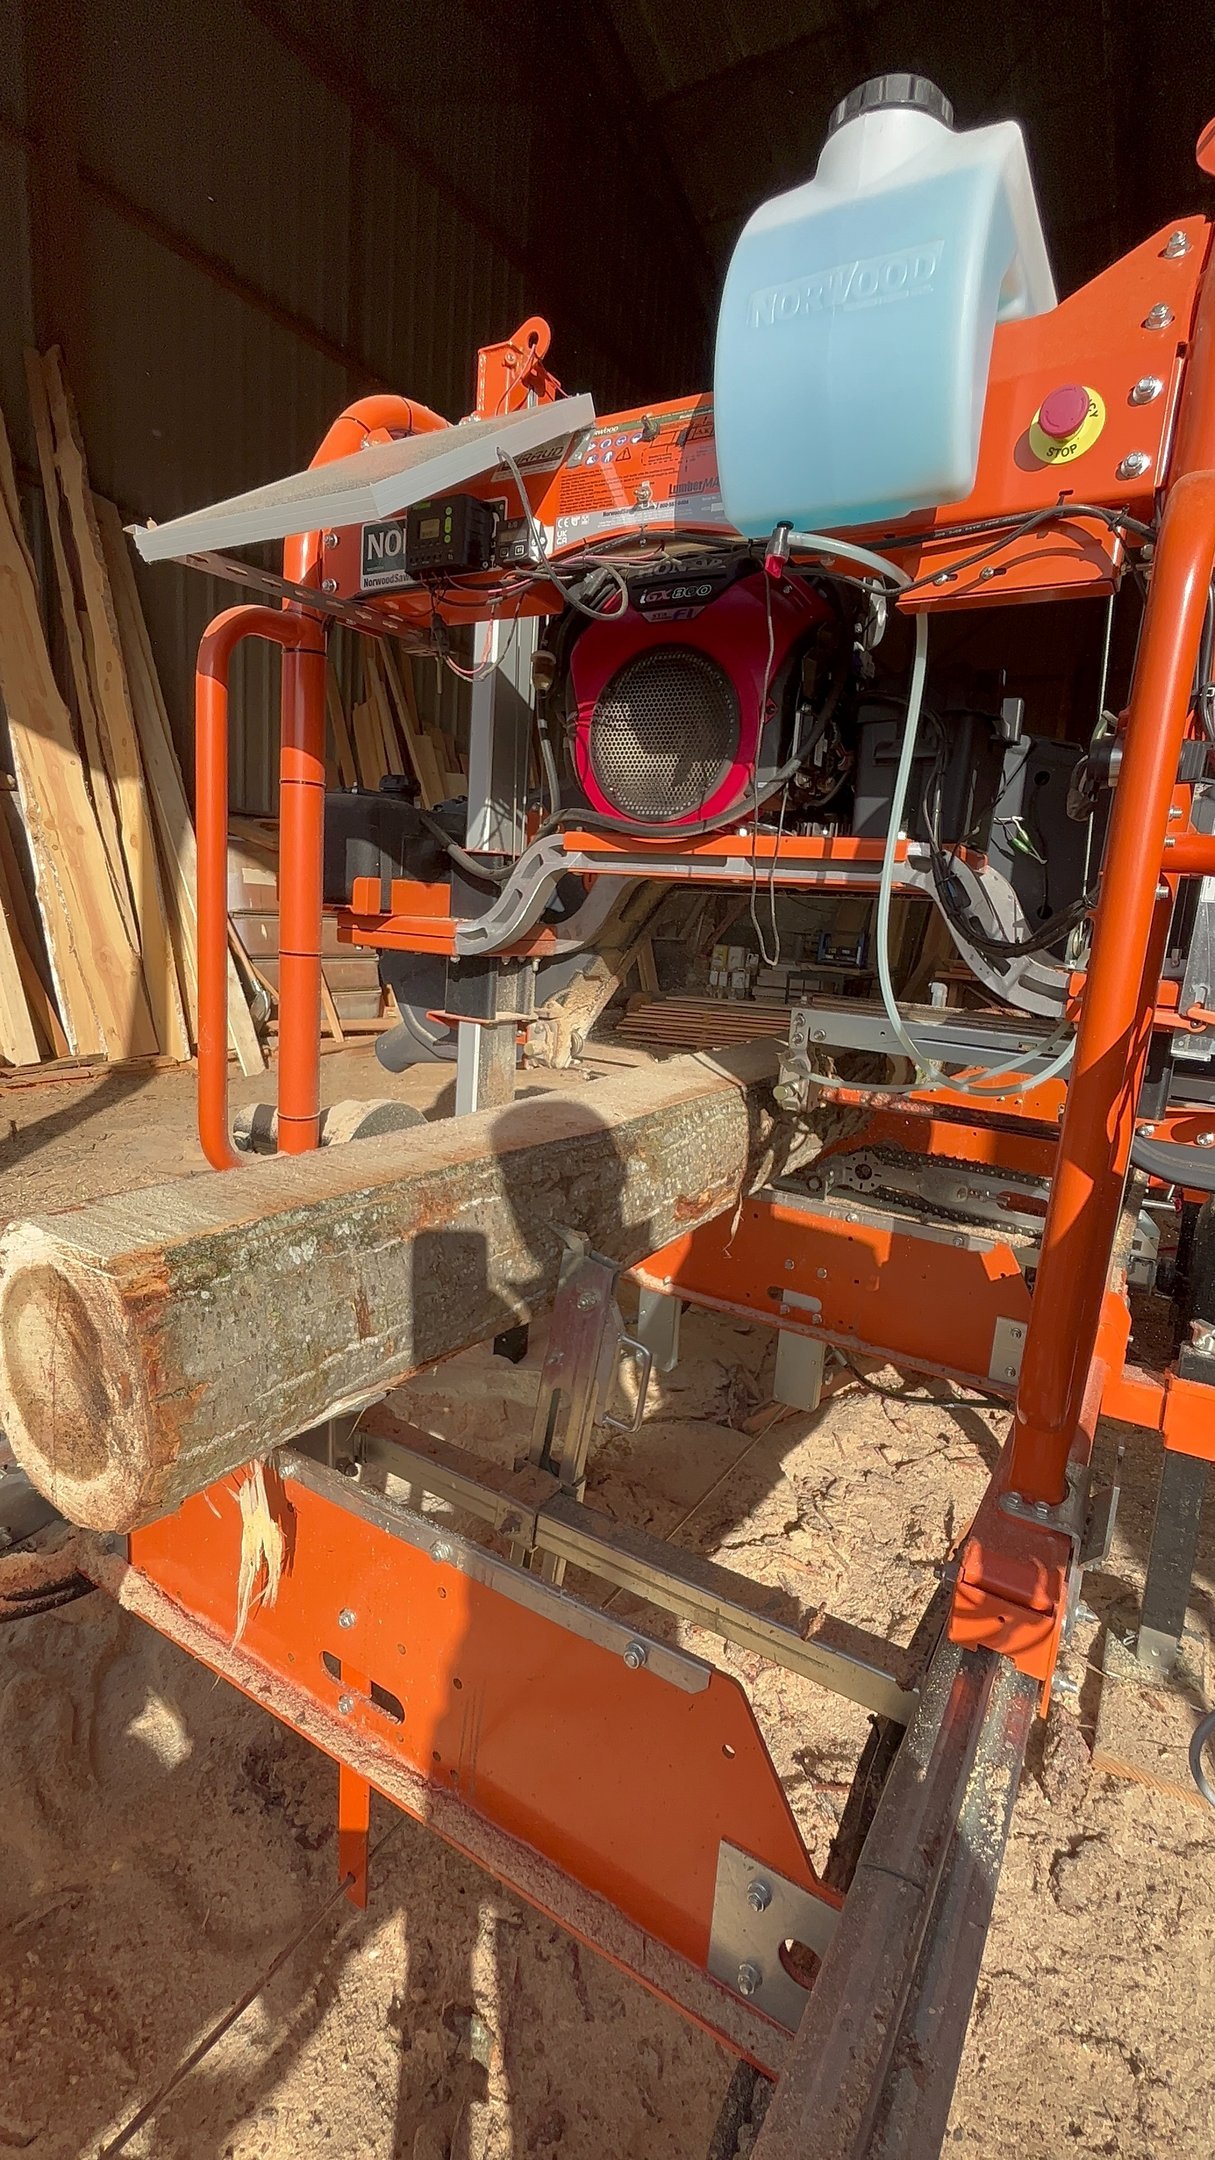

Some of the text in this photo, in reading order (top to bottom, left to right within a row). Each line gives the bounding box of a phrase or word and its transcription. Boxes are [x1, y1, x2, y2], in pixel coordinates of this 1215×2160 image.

[749, 254, 937, 329] NORWOOD
[1046, 443, 1077, 458] STOP
[669, 476, 720, 496] LumberMA
